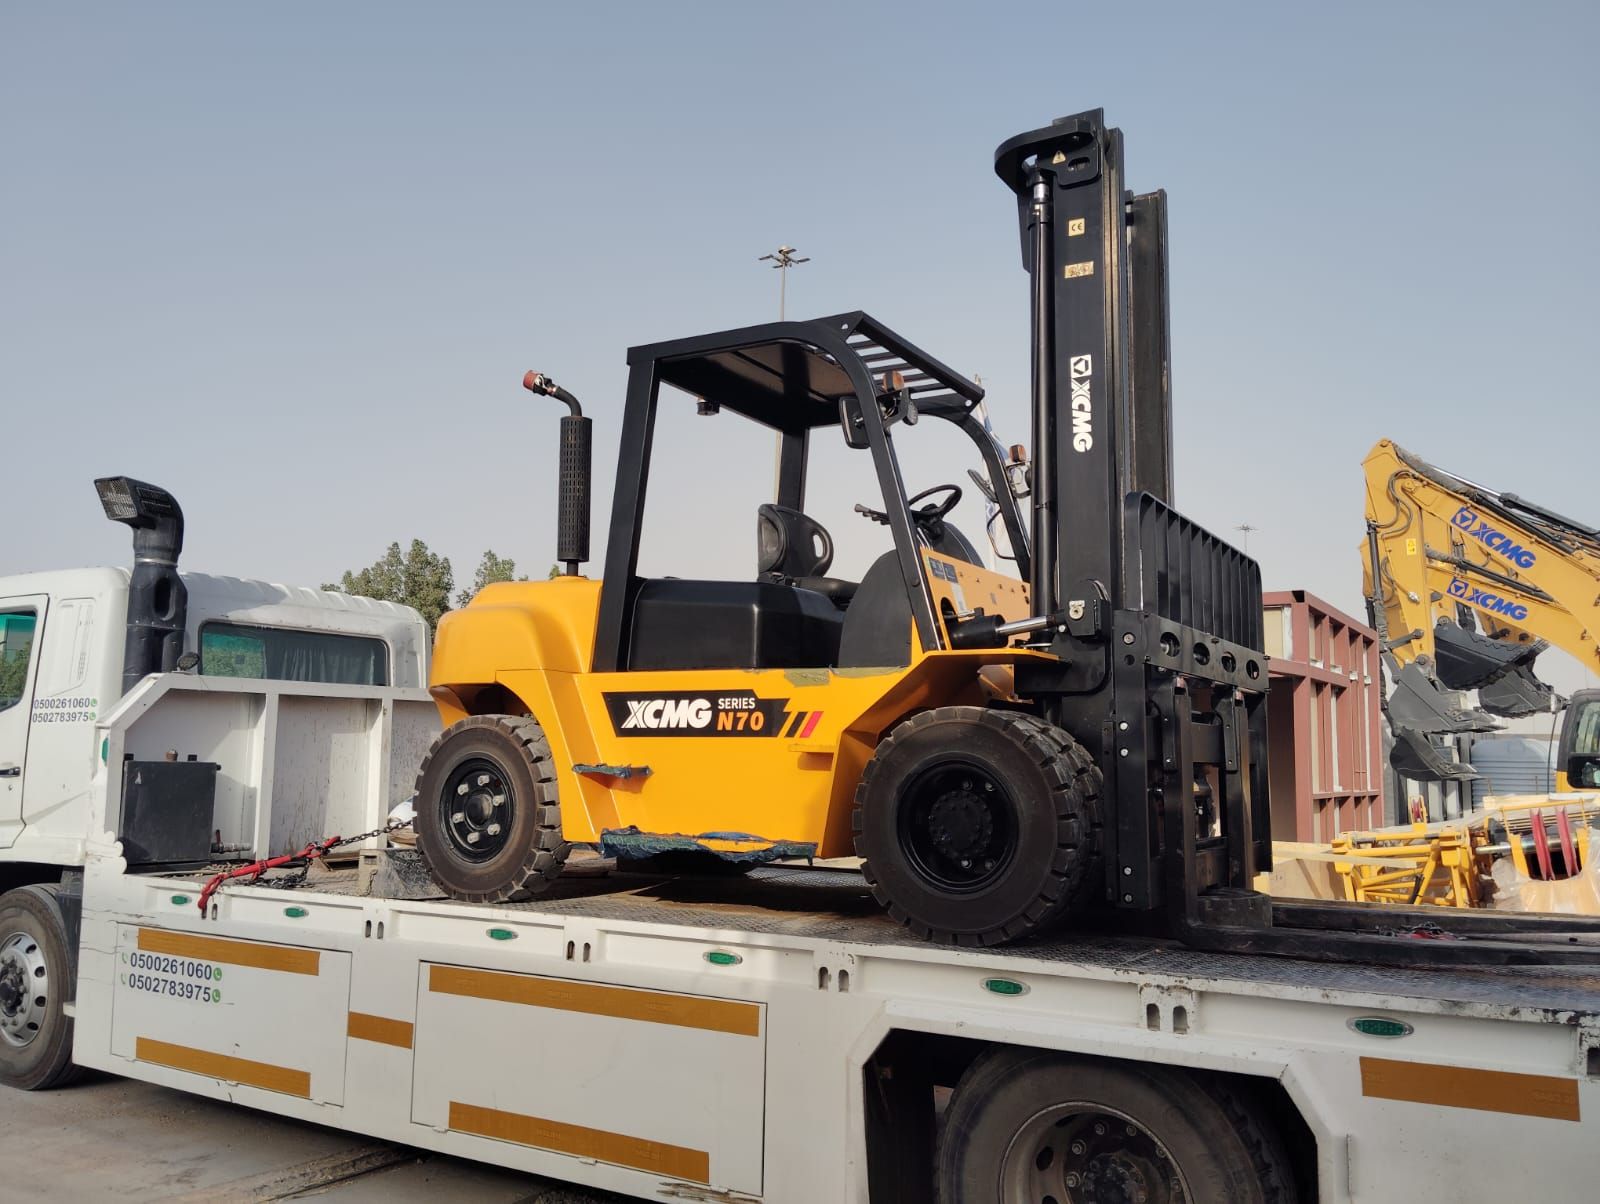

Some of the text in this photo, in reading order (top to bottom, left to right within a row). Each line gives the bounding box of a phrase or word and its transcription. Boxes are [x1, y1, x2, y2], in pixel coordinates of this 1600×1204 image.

[1071, 378, 1093, 452] XCMG
[1468, 521, 1536, 568] XCMG
[1466, 587, 1528, 620] XCMG
[32, 711, 89, 723] 0502783975
[33, 698, 91, 709] 0500261060
[621, 699, 712, 729] XCMG
[717, 698, 756, 709] SERIES
[717, 712, 764, 730] N70
[130, 952, 212, 980] 0500261060
[128, 973, 211, 1002] 0502783975
